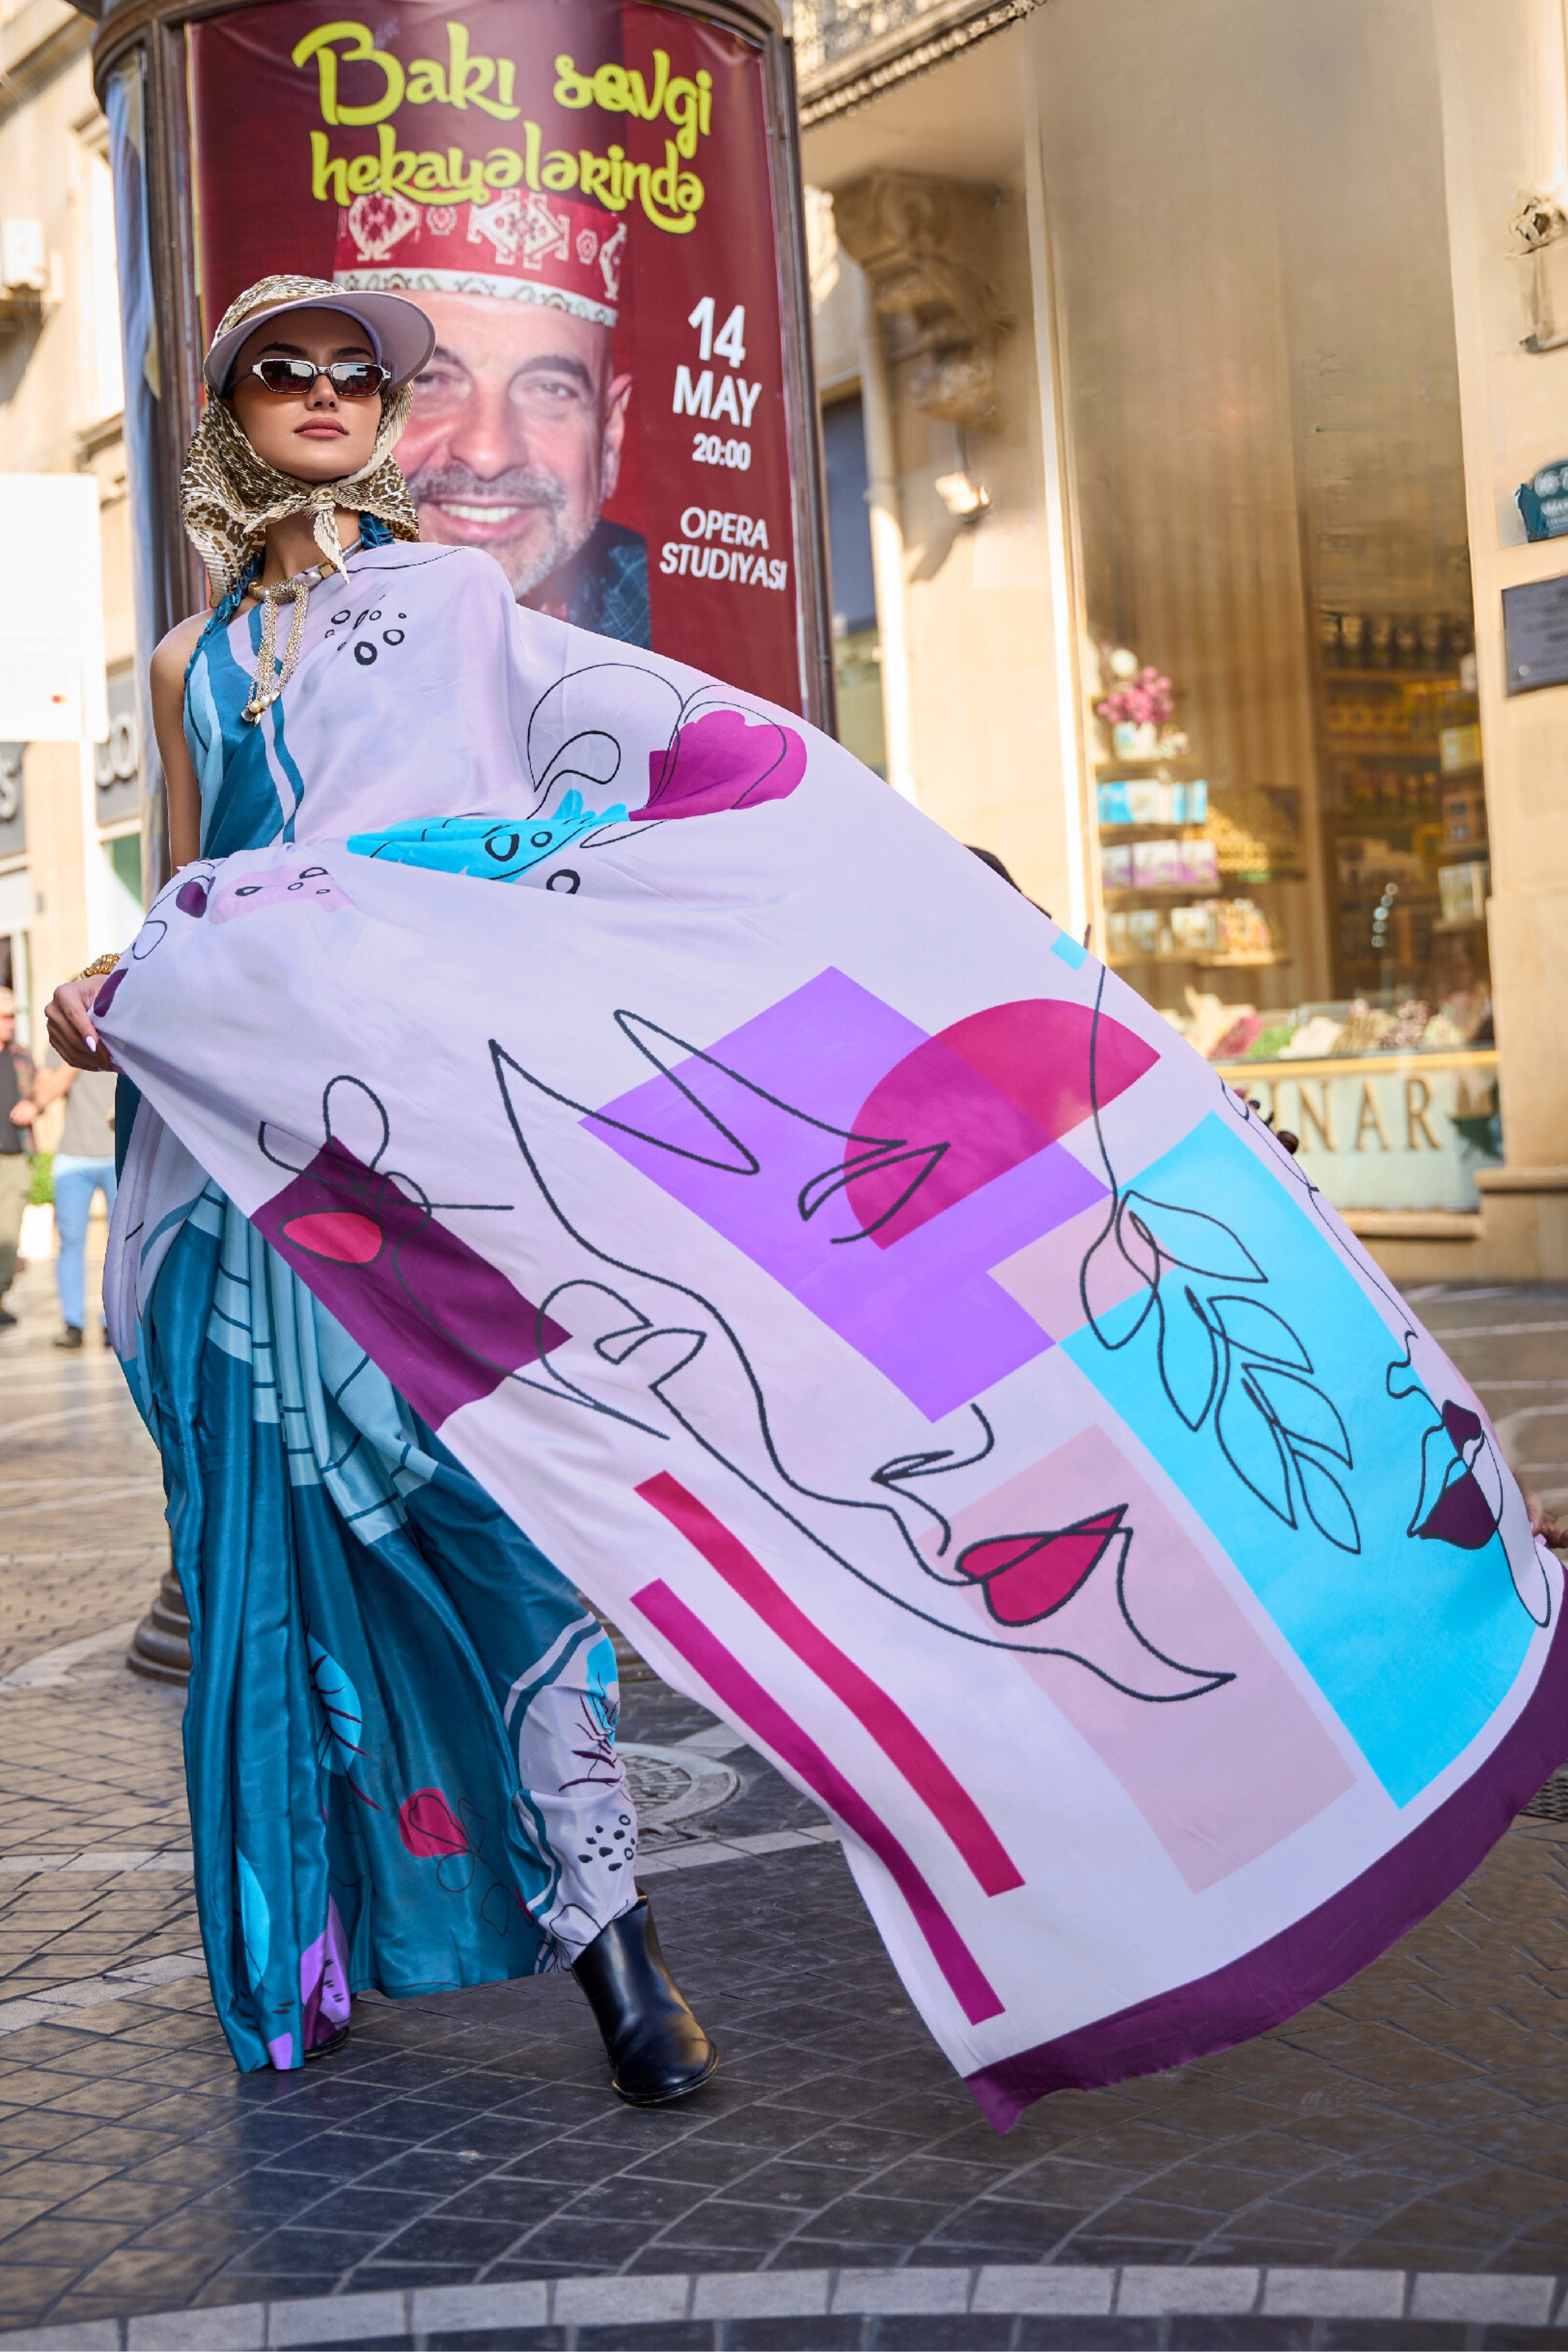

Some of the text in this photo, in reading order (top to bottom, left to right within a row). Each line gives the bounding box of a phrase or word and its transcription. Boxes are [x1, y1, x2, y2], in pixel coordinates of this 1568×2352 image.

[292, 21, 712, 159] Bakı sevgi
[688, 295, 746, 368] 14
[672, 364, 762, 428] MAY
[692, 432, 752, 471] 20:00
[680, 506, 769, 551] OPERA
